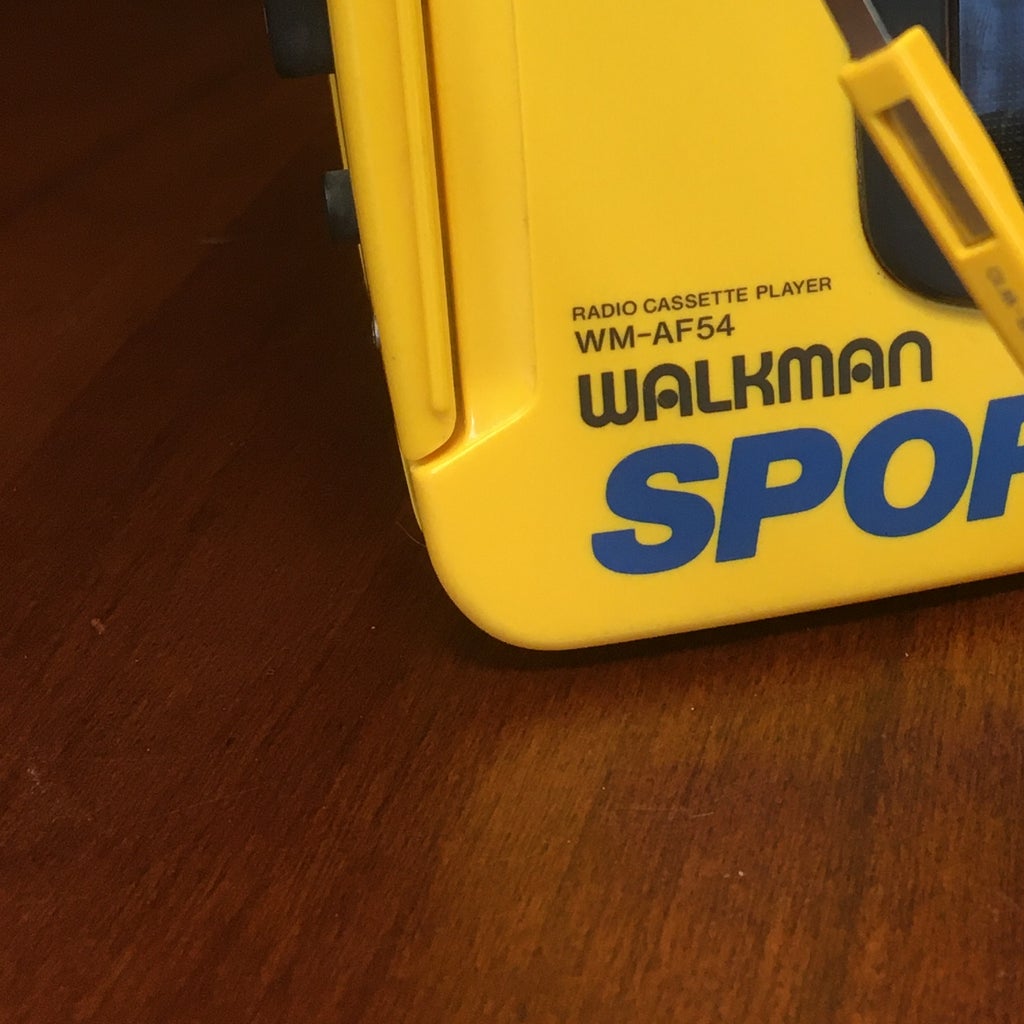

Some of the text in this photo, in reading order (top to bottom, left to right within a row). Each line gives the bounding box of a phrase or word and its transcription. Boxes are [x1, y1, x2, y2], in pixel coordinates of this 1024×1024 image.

[572, 276, 832, 321] RADIO CASSETTE PLAYER
[575, 313, 735, 354] WM-AF54
[578, 330, 933, 428] WALKMAN
